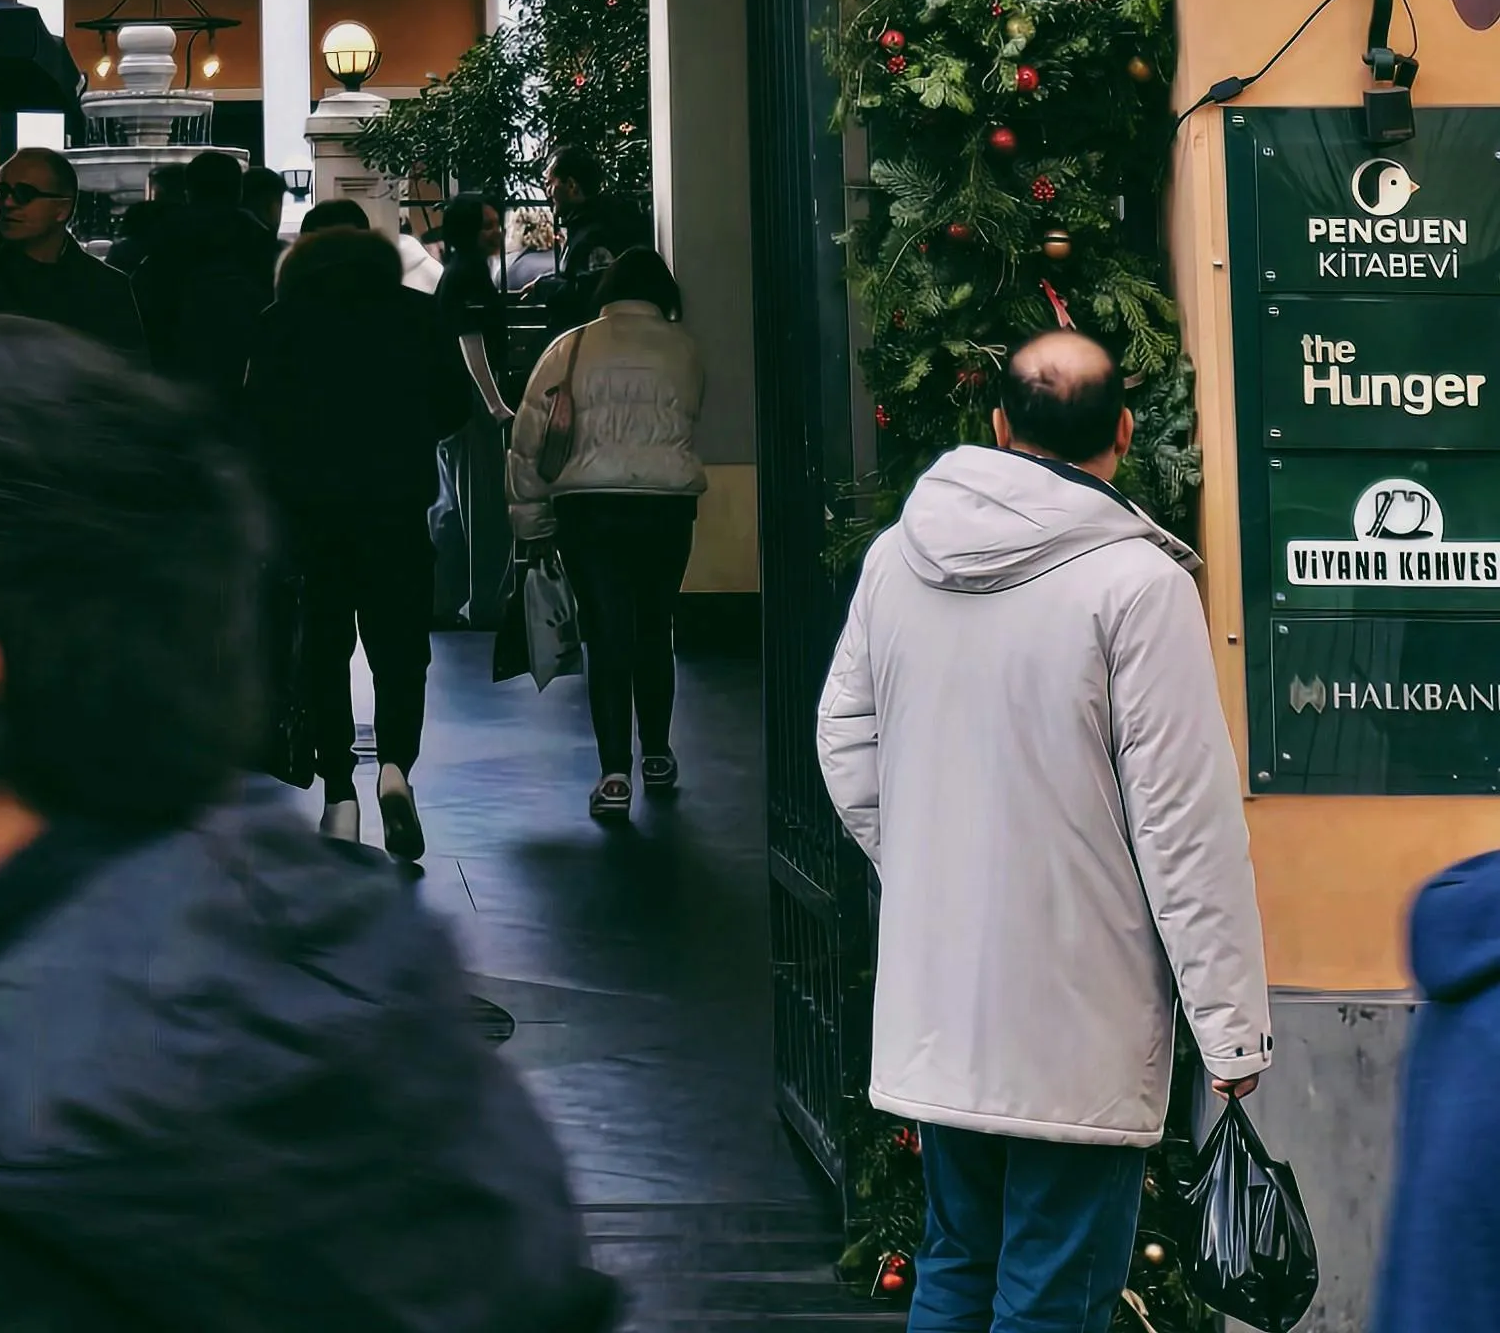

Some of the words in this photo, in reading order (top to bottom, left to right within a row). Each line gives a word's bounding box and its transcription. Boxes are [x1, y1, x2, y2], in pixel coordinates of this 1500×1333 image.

[1307, 217, 1468, 245] PENGUEN
[1318, 246, 1459, 279] KİTABEVİ
[1300, 333, 1357, 364] the
[1302, 364, 1487, 416] Hunger
[1332, 681, 1500, 712] HALKBAN
